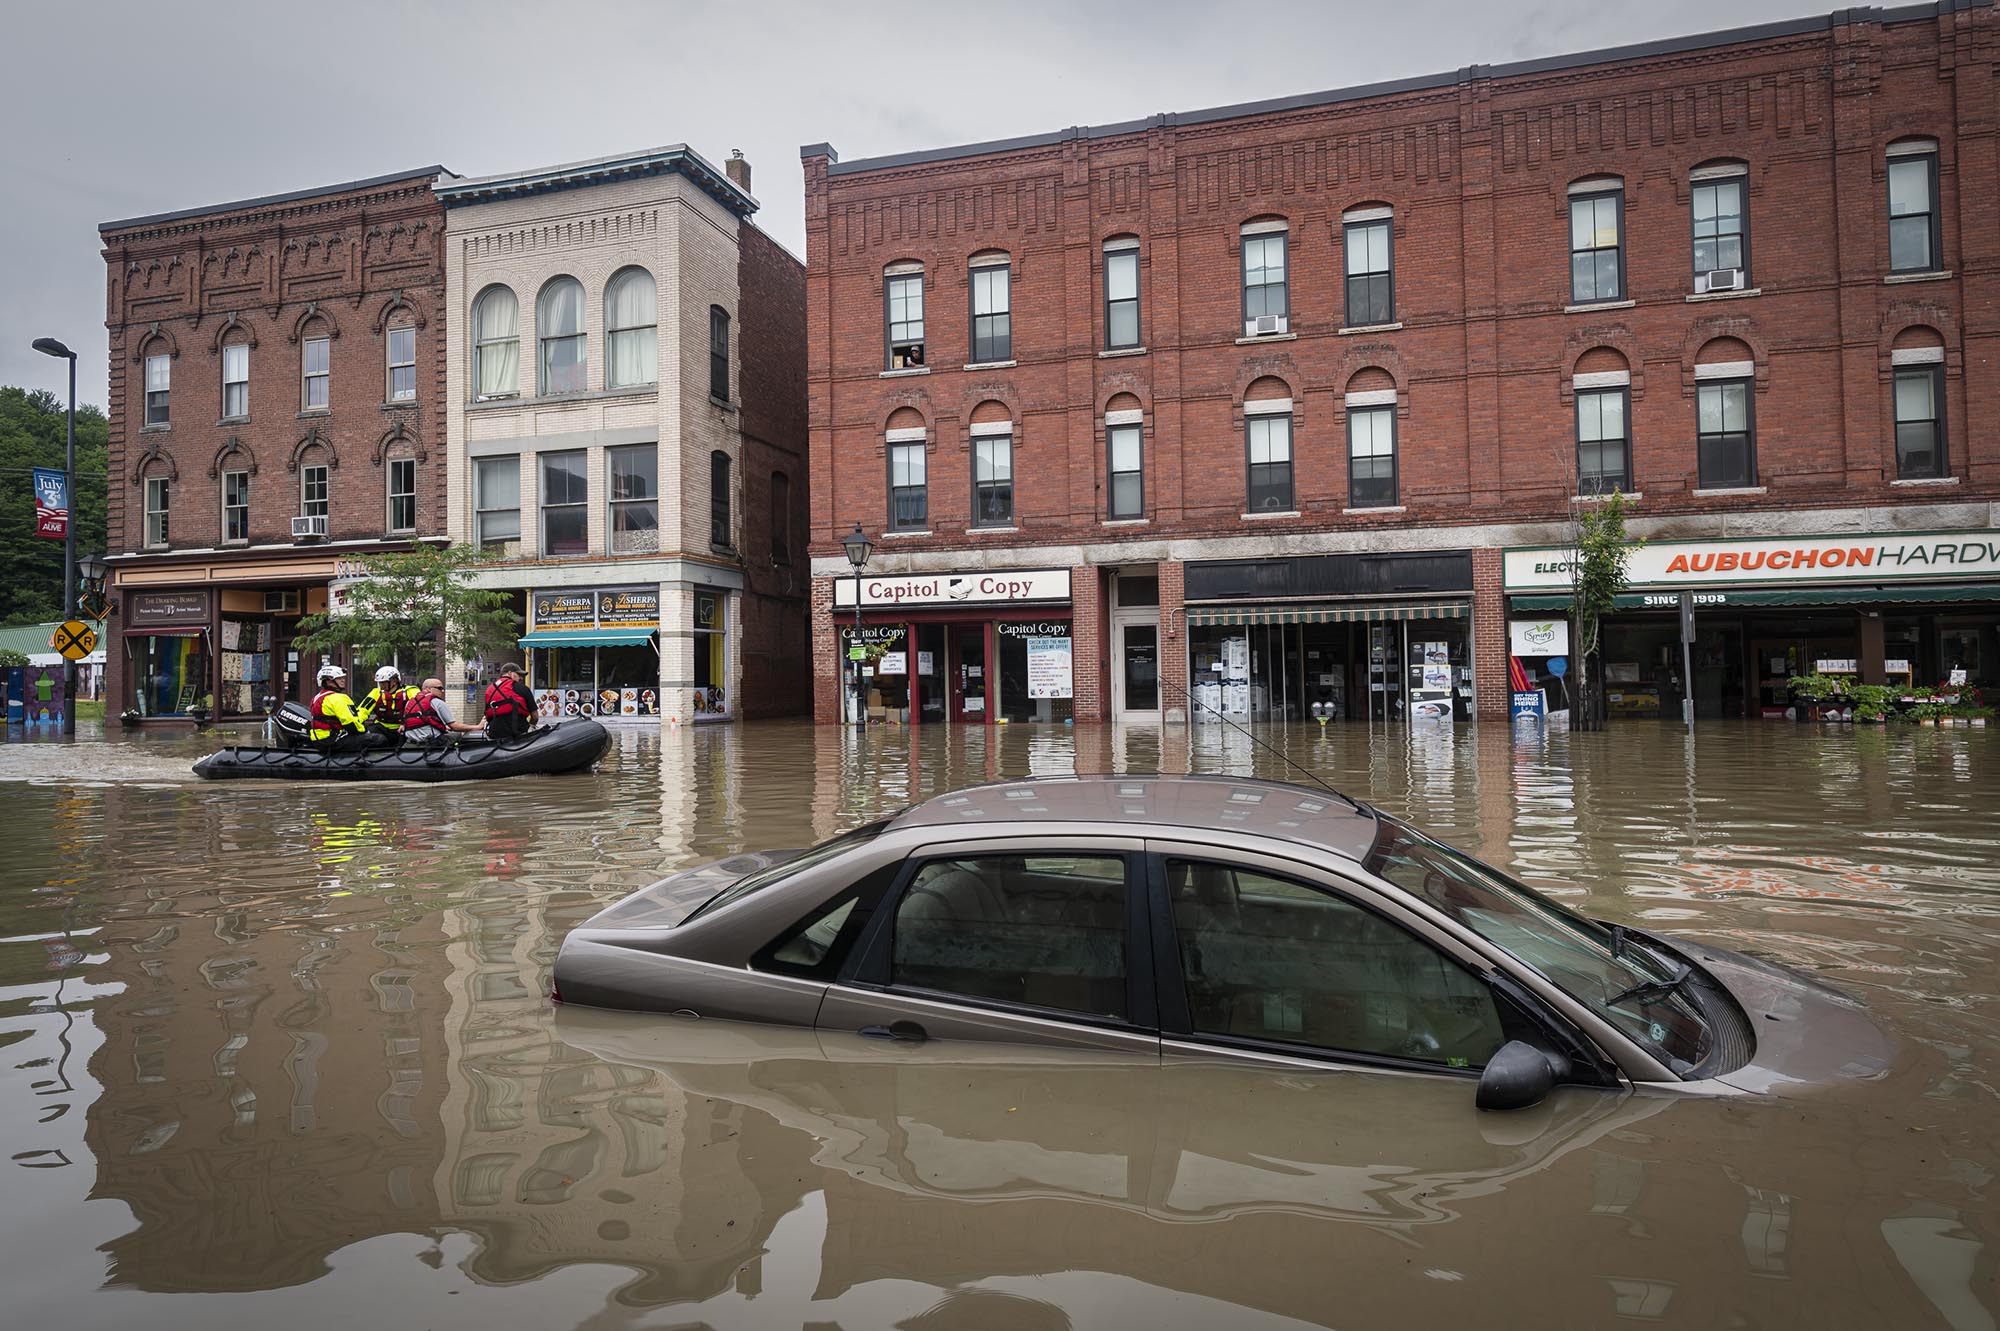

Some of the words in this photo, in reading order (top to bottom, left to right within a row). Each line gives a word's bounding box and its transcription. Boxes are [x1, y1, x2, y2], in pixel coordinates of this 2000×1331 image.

[38, 478, 62, 494] July
[44, 490, 61, 507] 3rd
[1666, 547, 1874, 573] AUBUCHON
[868, 580, 940, 602] Capitol
[980, 578, 1032, 598] Copy
[1644, 595, 1678, 604] SINC
[1692, 594, 1726, 603] 1908
[842, 627, 878, 638] Caitol
[880, 627, 906, 639] Copy
[998, 624, 1036, 636] Capitol
[1038, 623, 1067, 635] Copy
[57, 635, 65, 644] R
[84, 636, 92, 646] R
[1527, 631, 1552, 643] Spring
[280, 710, 308, 725] EVINRUDE
